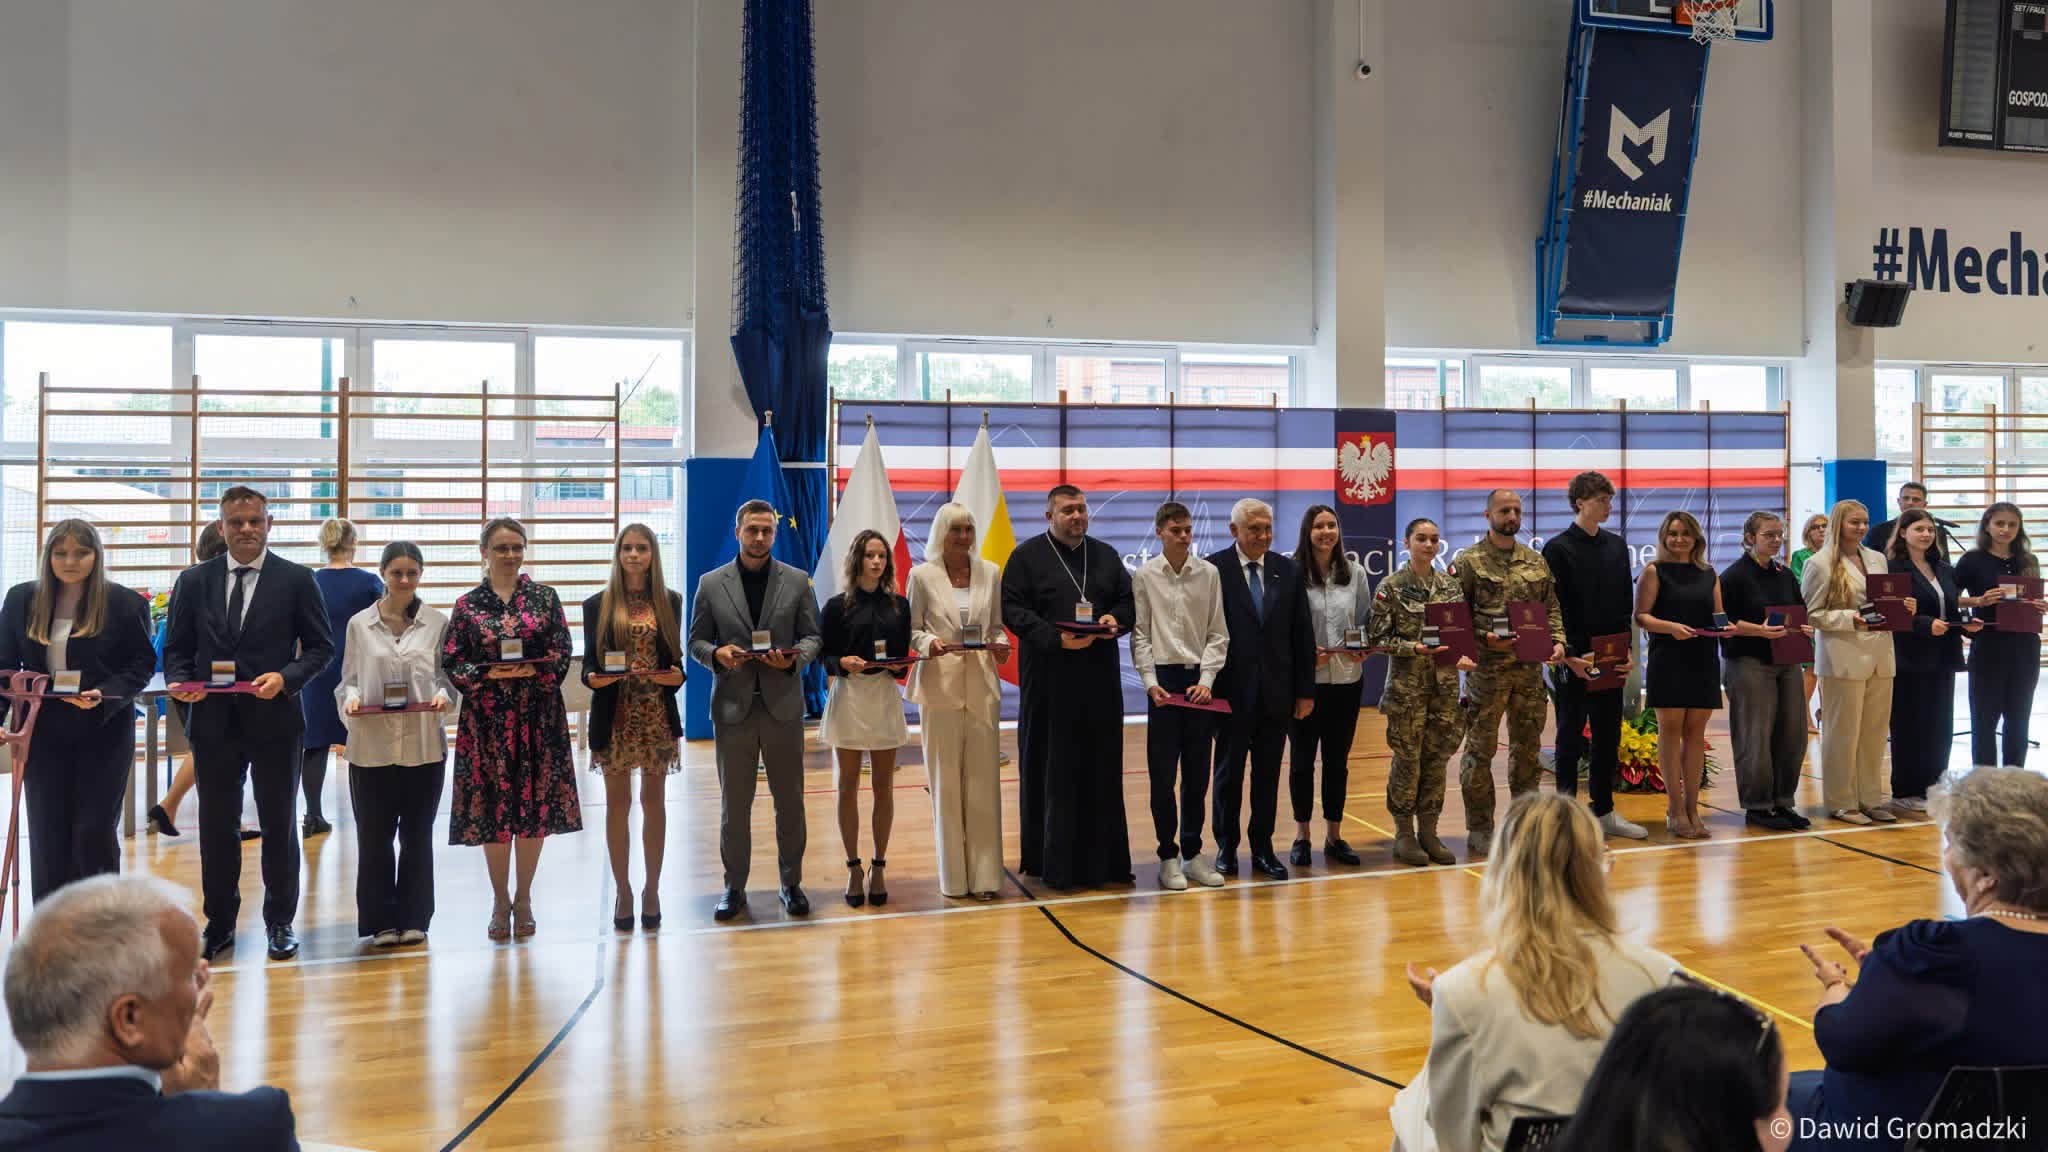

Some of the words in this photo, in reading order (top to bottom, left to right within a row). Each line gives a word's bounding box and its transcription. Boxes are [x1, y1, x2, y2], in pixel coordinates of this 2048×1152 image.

[2008, 90, 2048, 108] GOSPOD
[1583, 189, 1673, 212] #Mechaniak
[1872, 226, 2048, 295] #Mech
